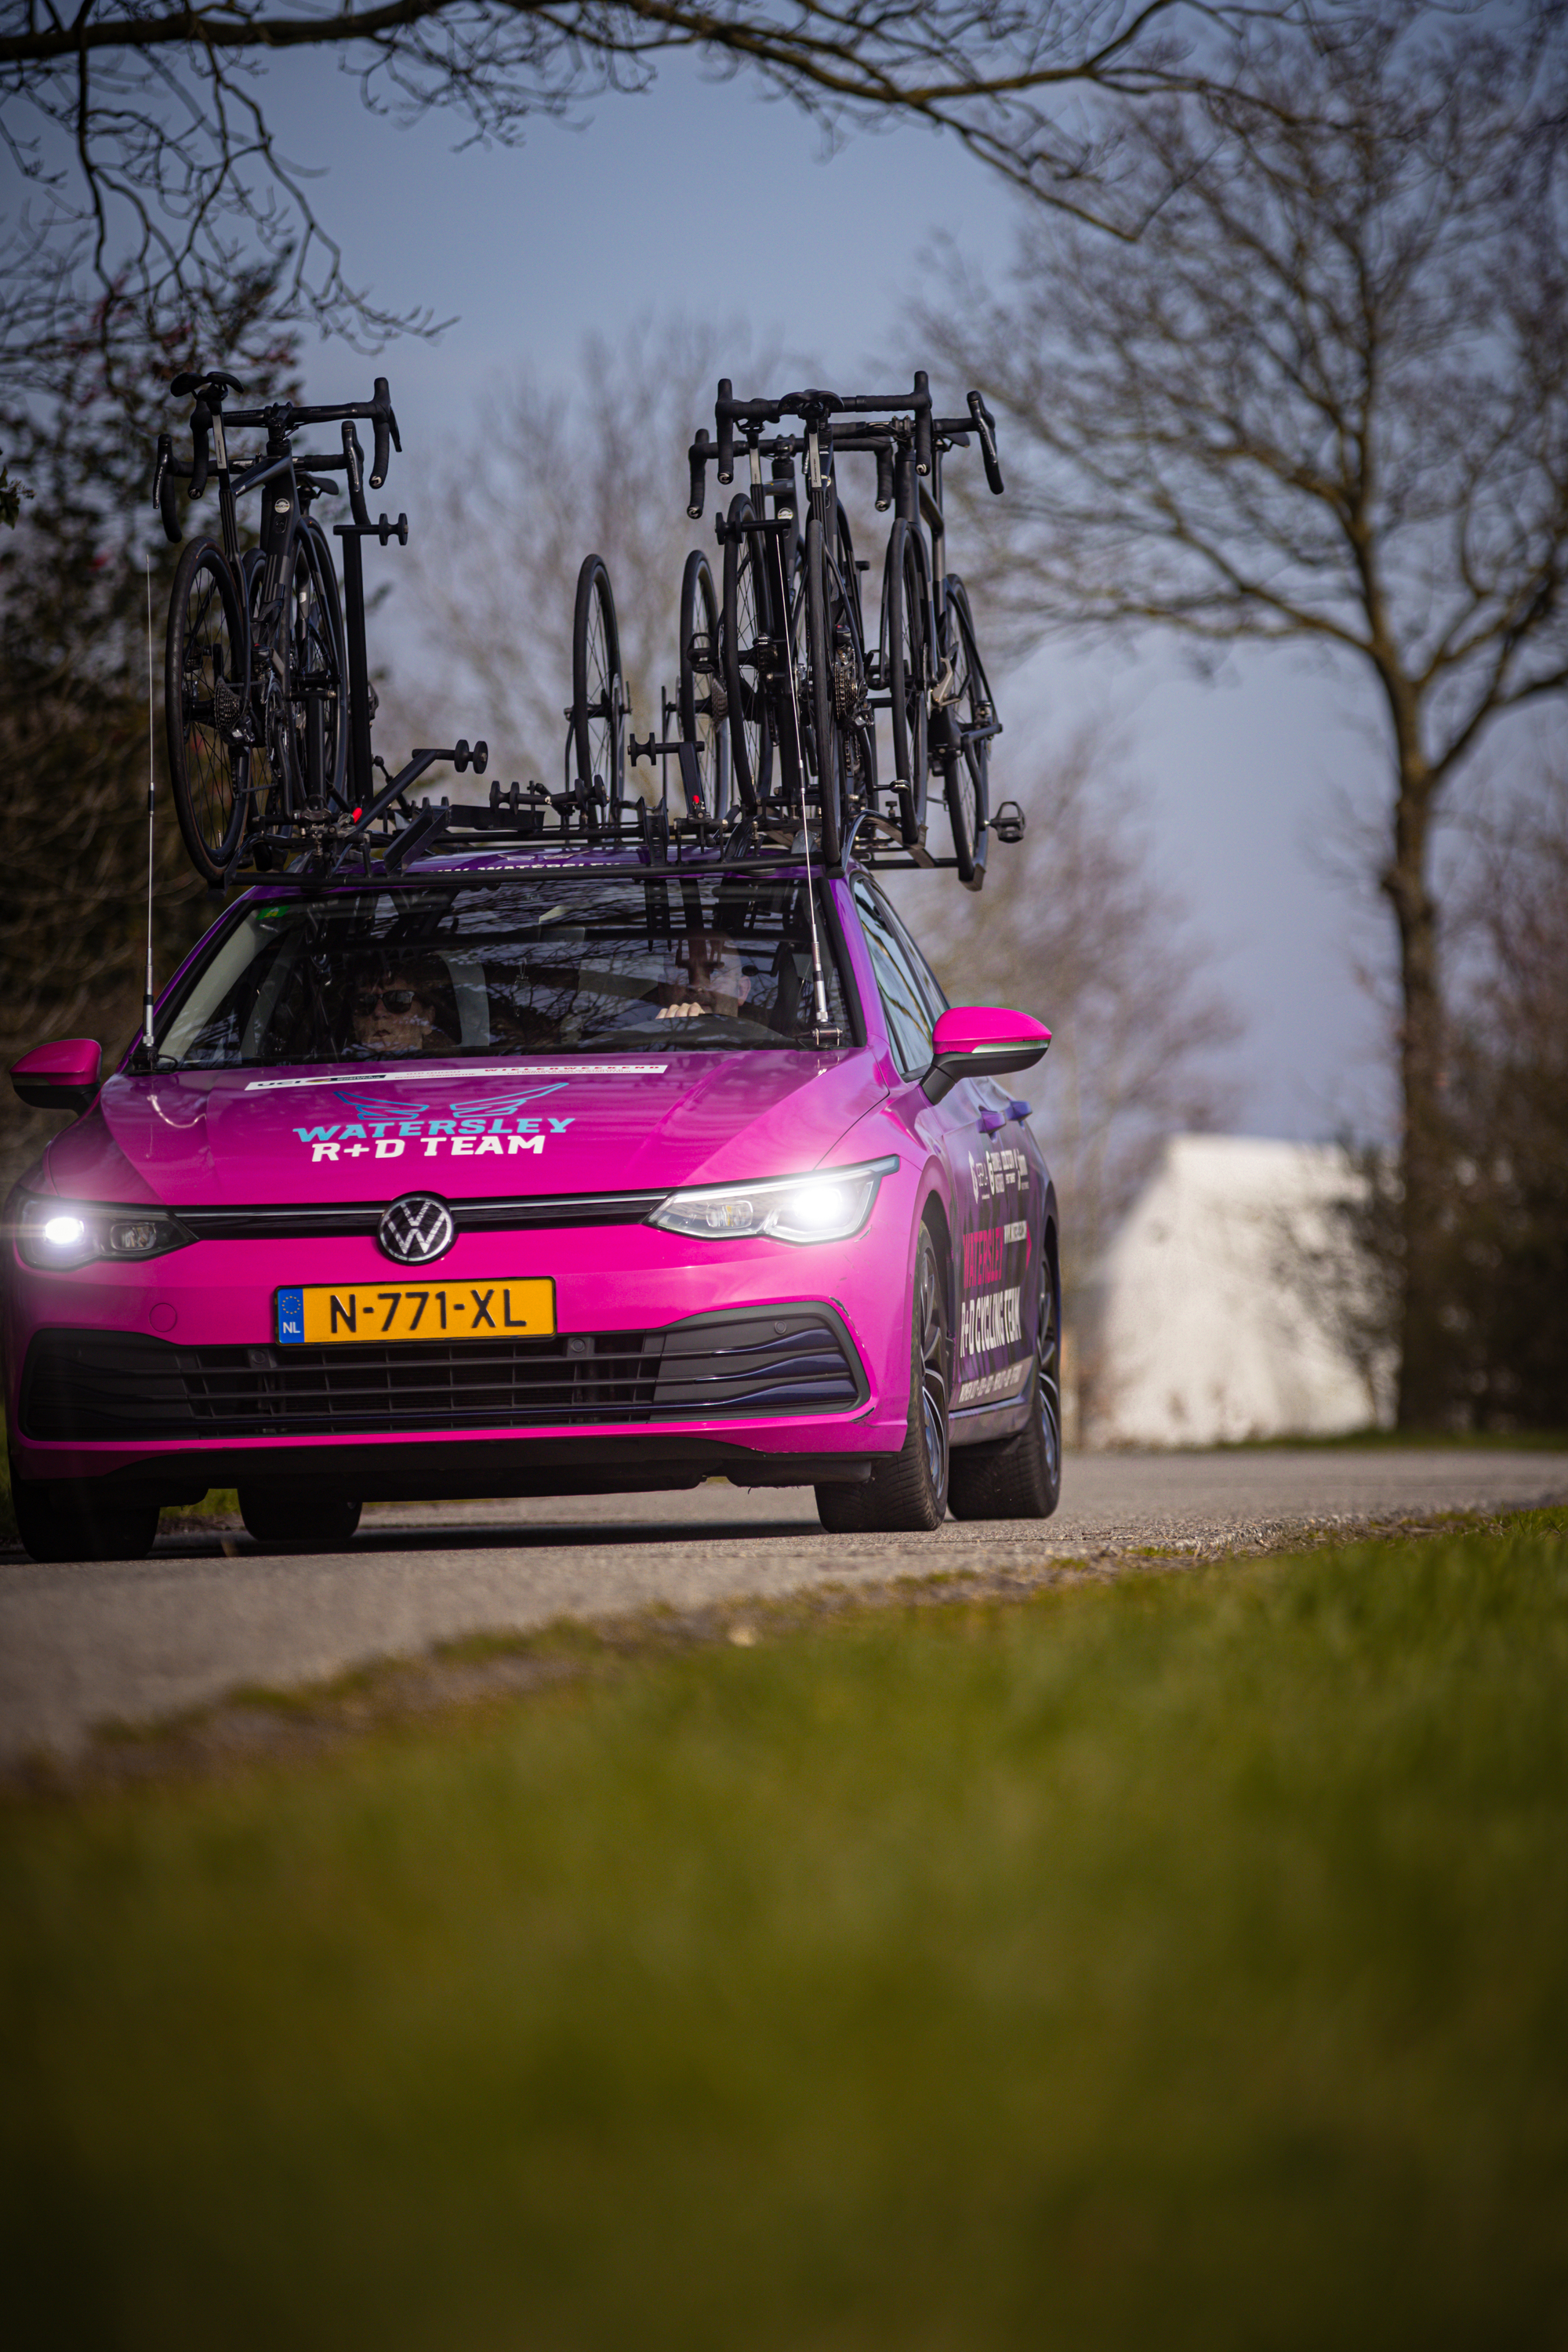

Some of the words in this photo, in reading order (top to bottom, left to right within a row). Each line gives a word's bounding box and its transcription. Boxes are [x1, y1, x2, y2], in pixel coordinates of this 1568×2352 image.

[292, 1118, 575, 1142] WATERSLEY
[311, 1139, 405, 1162] R+D
[420, 1135, 546, 1156] TEAM
[963, 1225, 1004, 1289] WATERSLEY
[282, 1321, 301, 1334] NL
[330, 1288, 527, 1334] N-771-XL
[960, 1299, 975, 1359] R+D
[975, 1291, 1006, 1354] CYCLING
[1004, 1287, 1022, 1345] TEAM
